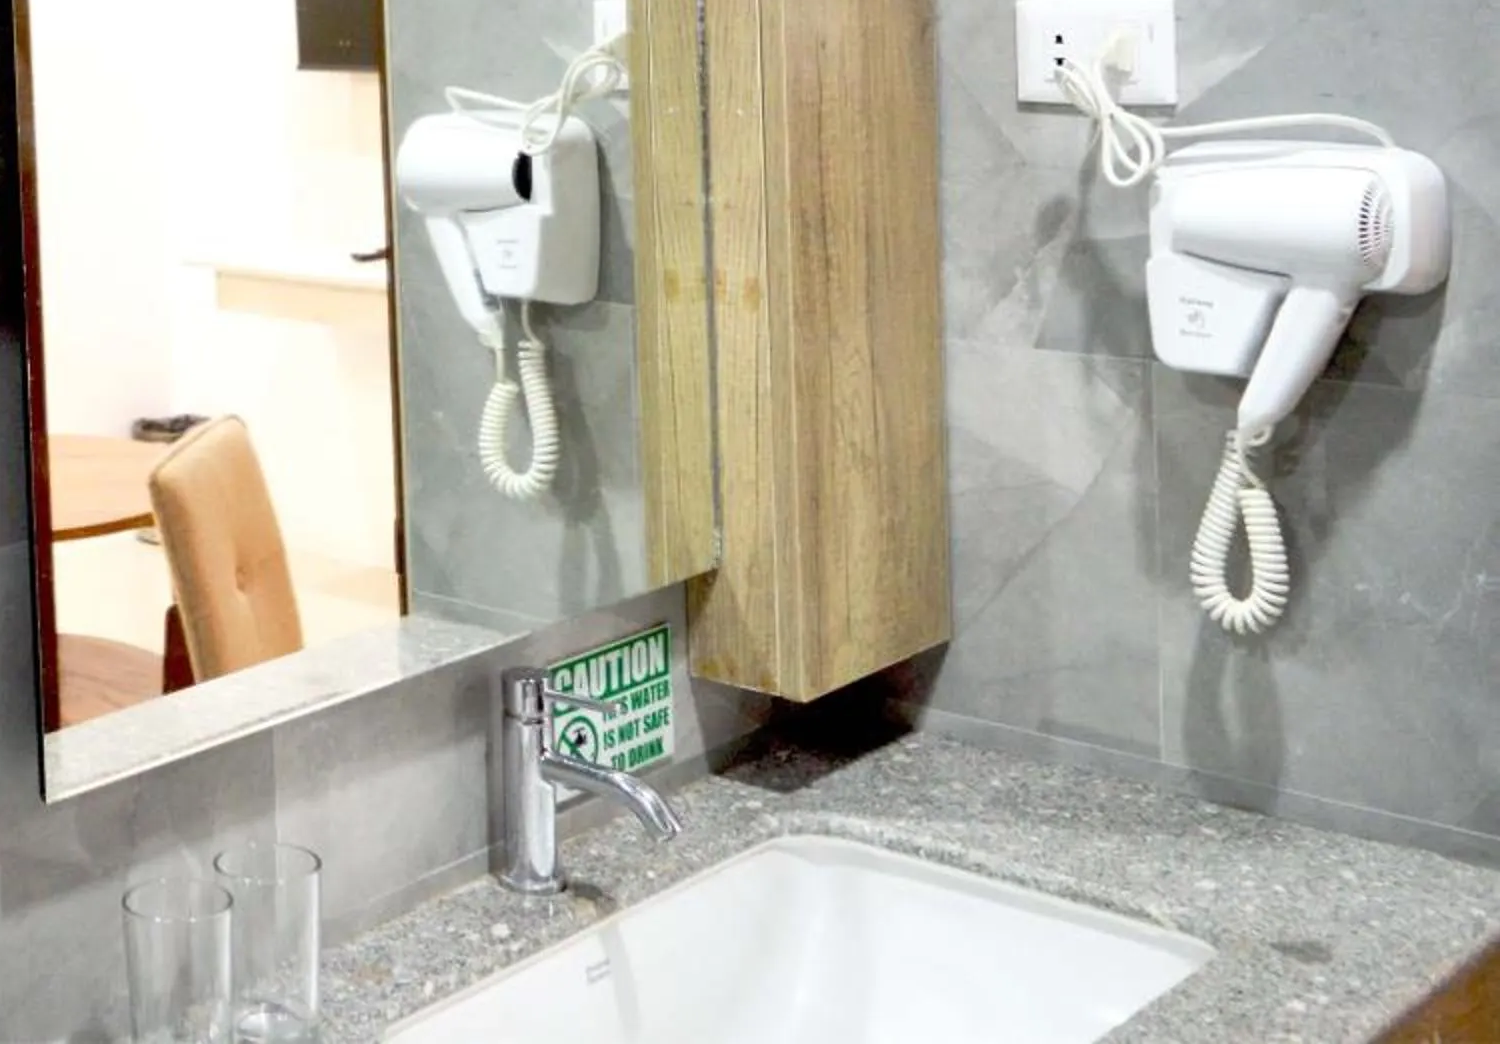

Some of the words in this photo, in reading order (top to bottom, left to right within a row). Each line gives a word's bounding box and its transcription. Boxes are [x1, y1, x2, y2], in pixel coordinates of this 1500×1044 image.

[554, 631, 665, 712] CAUTION
[630, 679, 670, 711] WATER
[603, 728, 615, 751] IS
[617, 718, 641, 744] NOT
[643, 706, 670, 734] SAFE
[628, 736, 665, 768] DRINK
